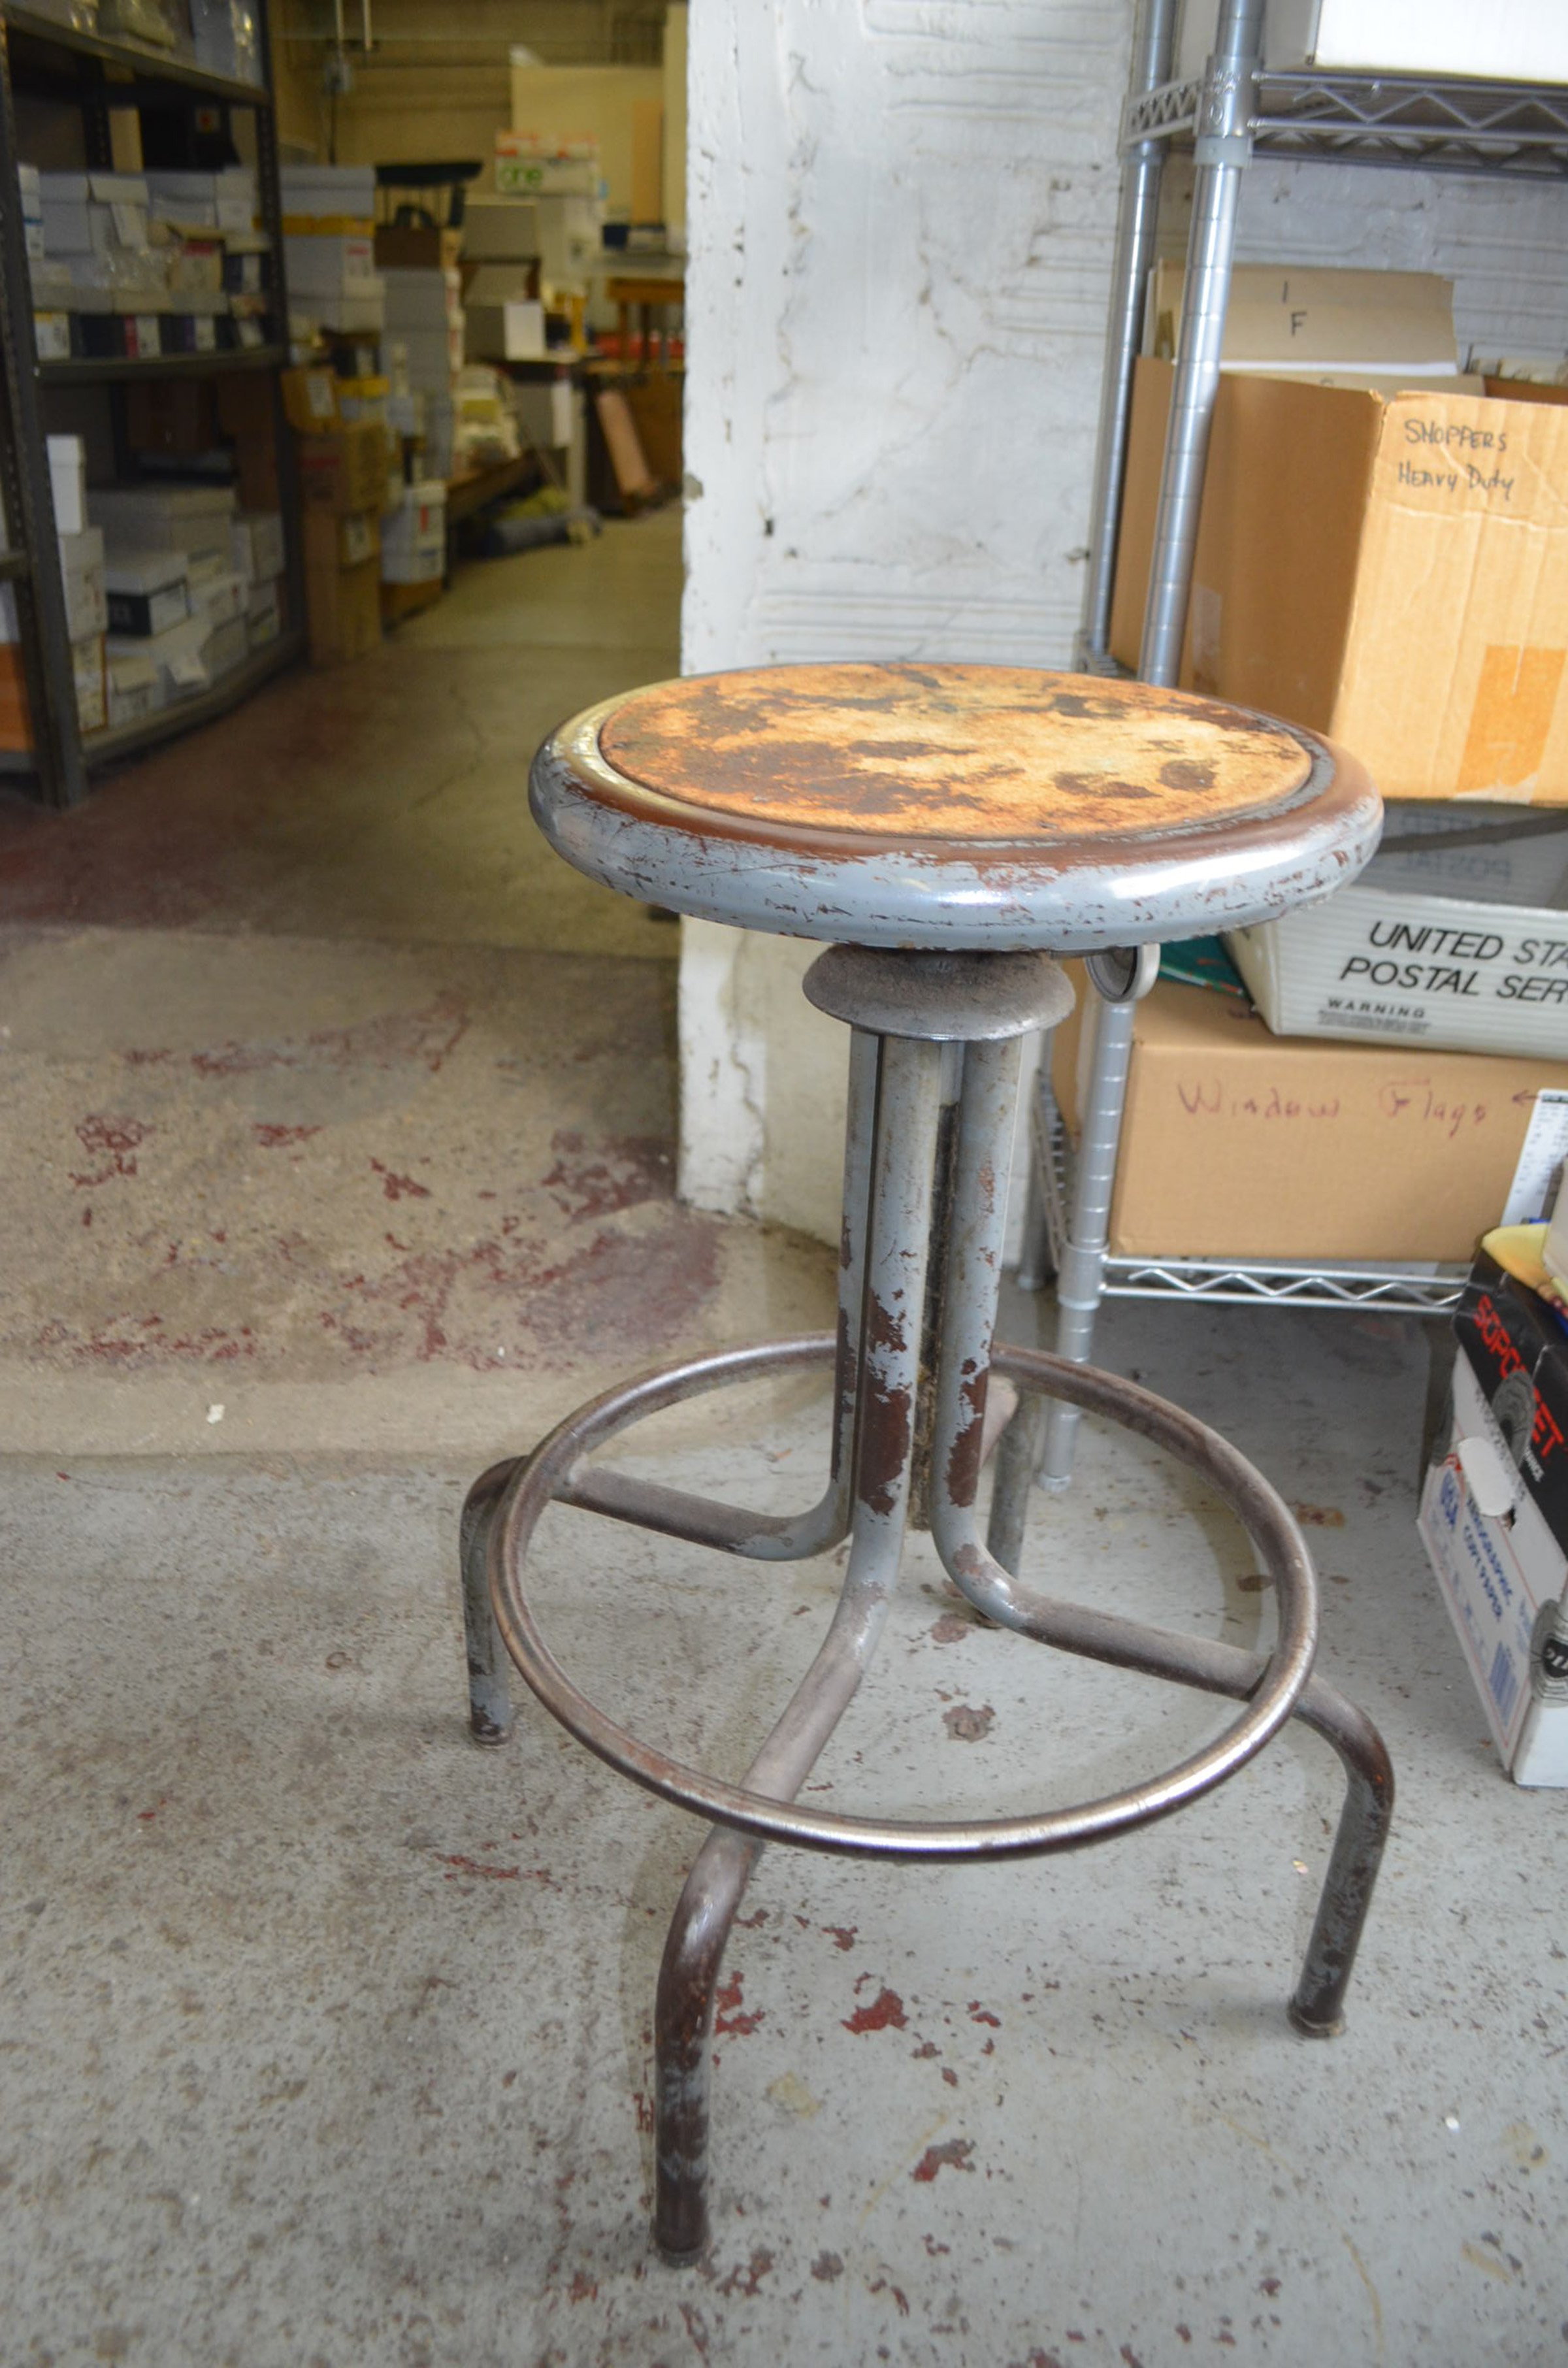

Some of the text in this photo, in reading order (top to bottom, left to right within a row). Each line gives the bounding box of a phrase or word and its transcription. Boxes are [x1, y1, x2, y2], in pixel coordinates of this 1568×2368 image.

[1291, 310, 1307, 337] F
[1404, 419, 1507, 452] SHOPPERS
[1369, 921, 1504, 960] UNITED
[1340, 957, 1568, 1004] POSTAL SER
[1327, 997, 1426, 1019] WARNING
[1177, 1078, 1340, 1119] Window
